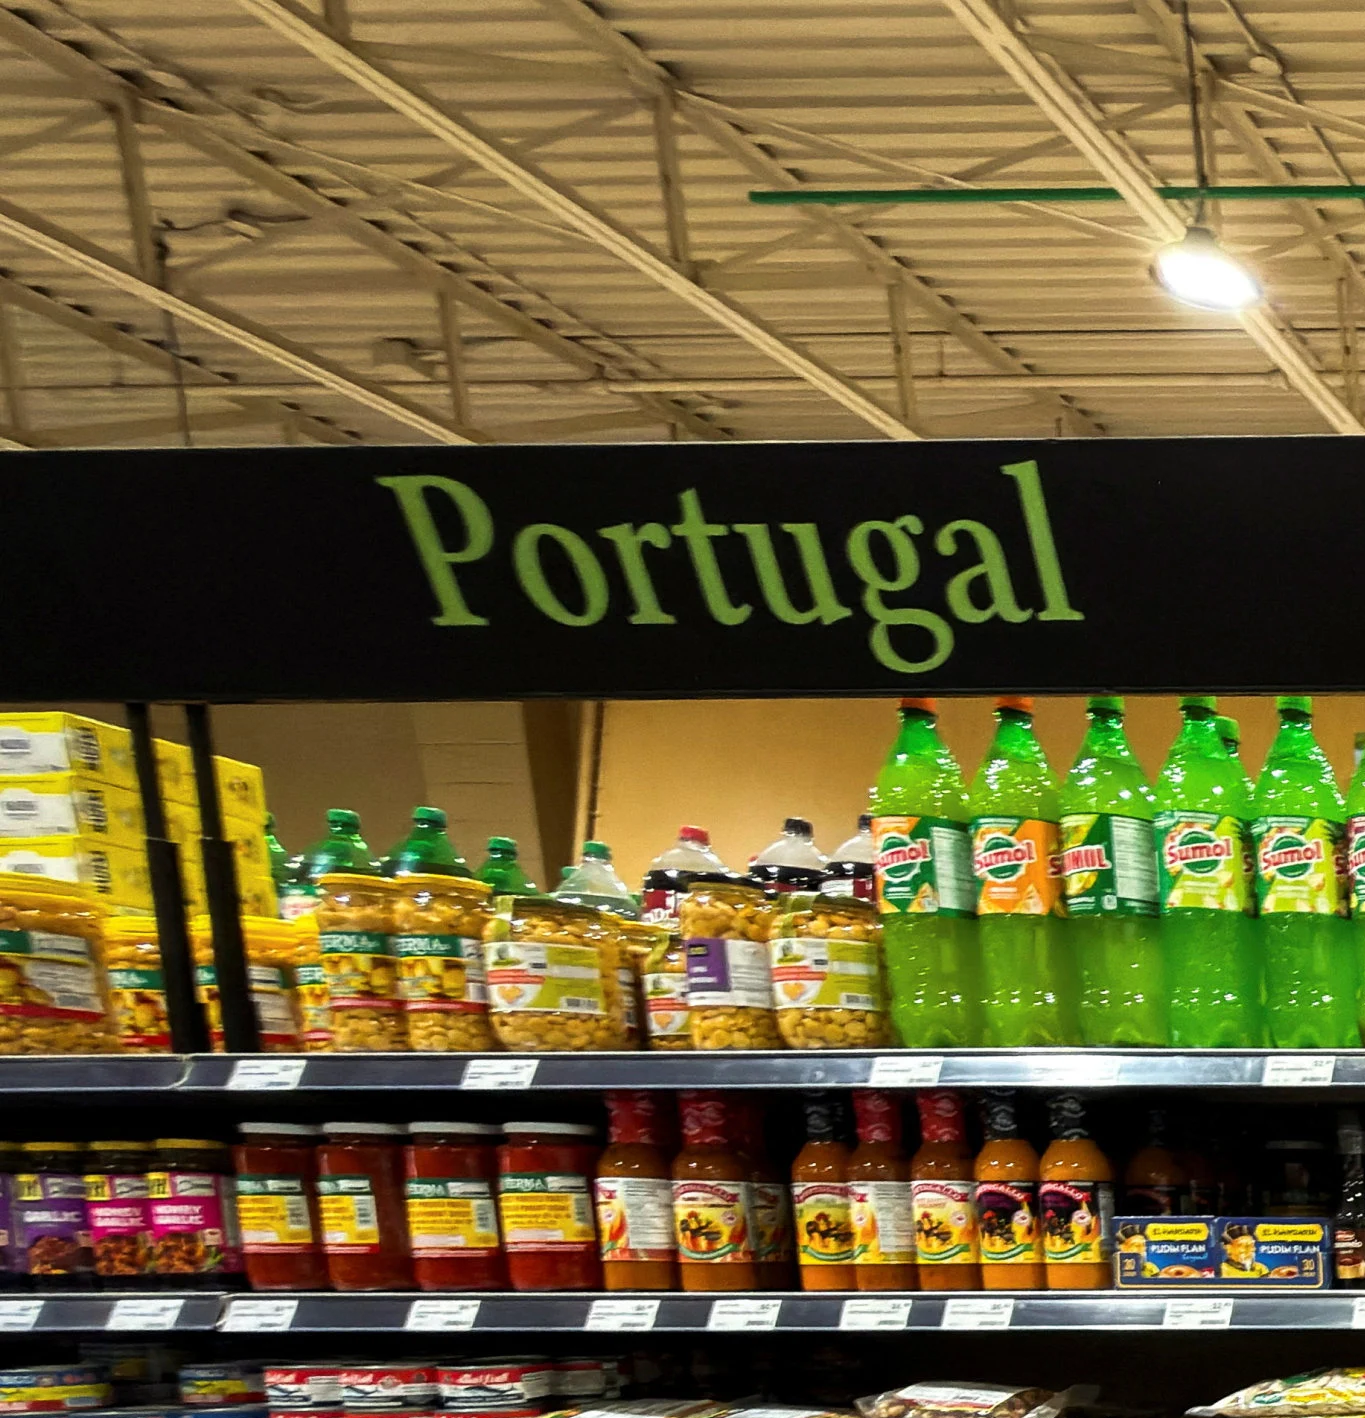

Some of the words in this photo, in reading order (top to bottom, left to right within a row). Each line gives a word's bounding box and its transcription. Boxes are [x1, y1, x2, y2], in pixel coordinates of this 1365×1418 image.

[378, 461, 1084, 674] Portugal
[1167, 840, 1232, 864] Sumol
[1261, 842, 1323, 870] Sumol
